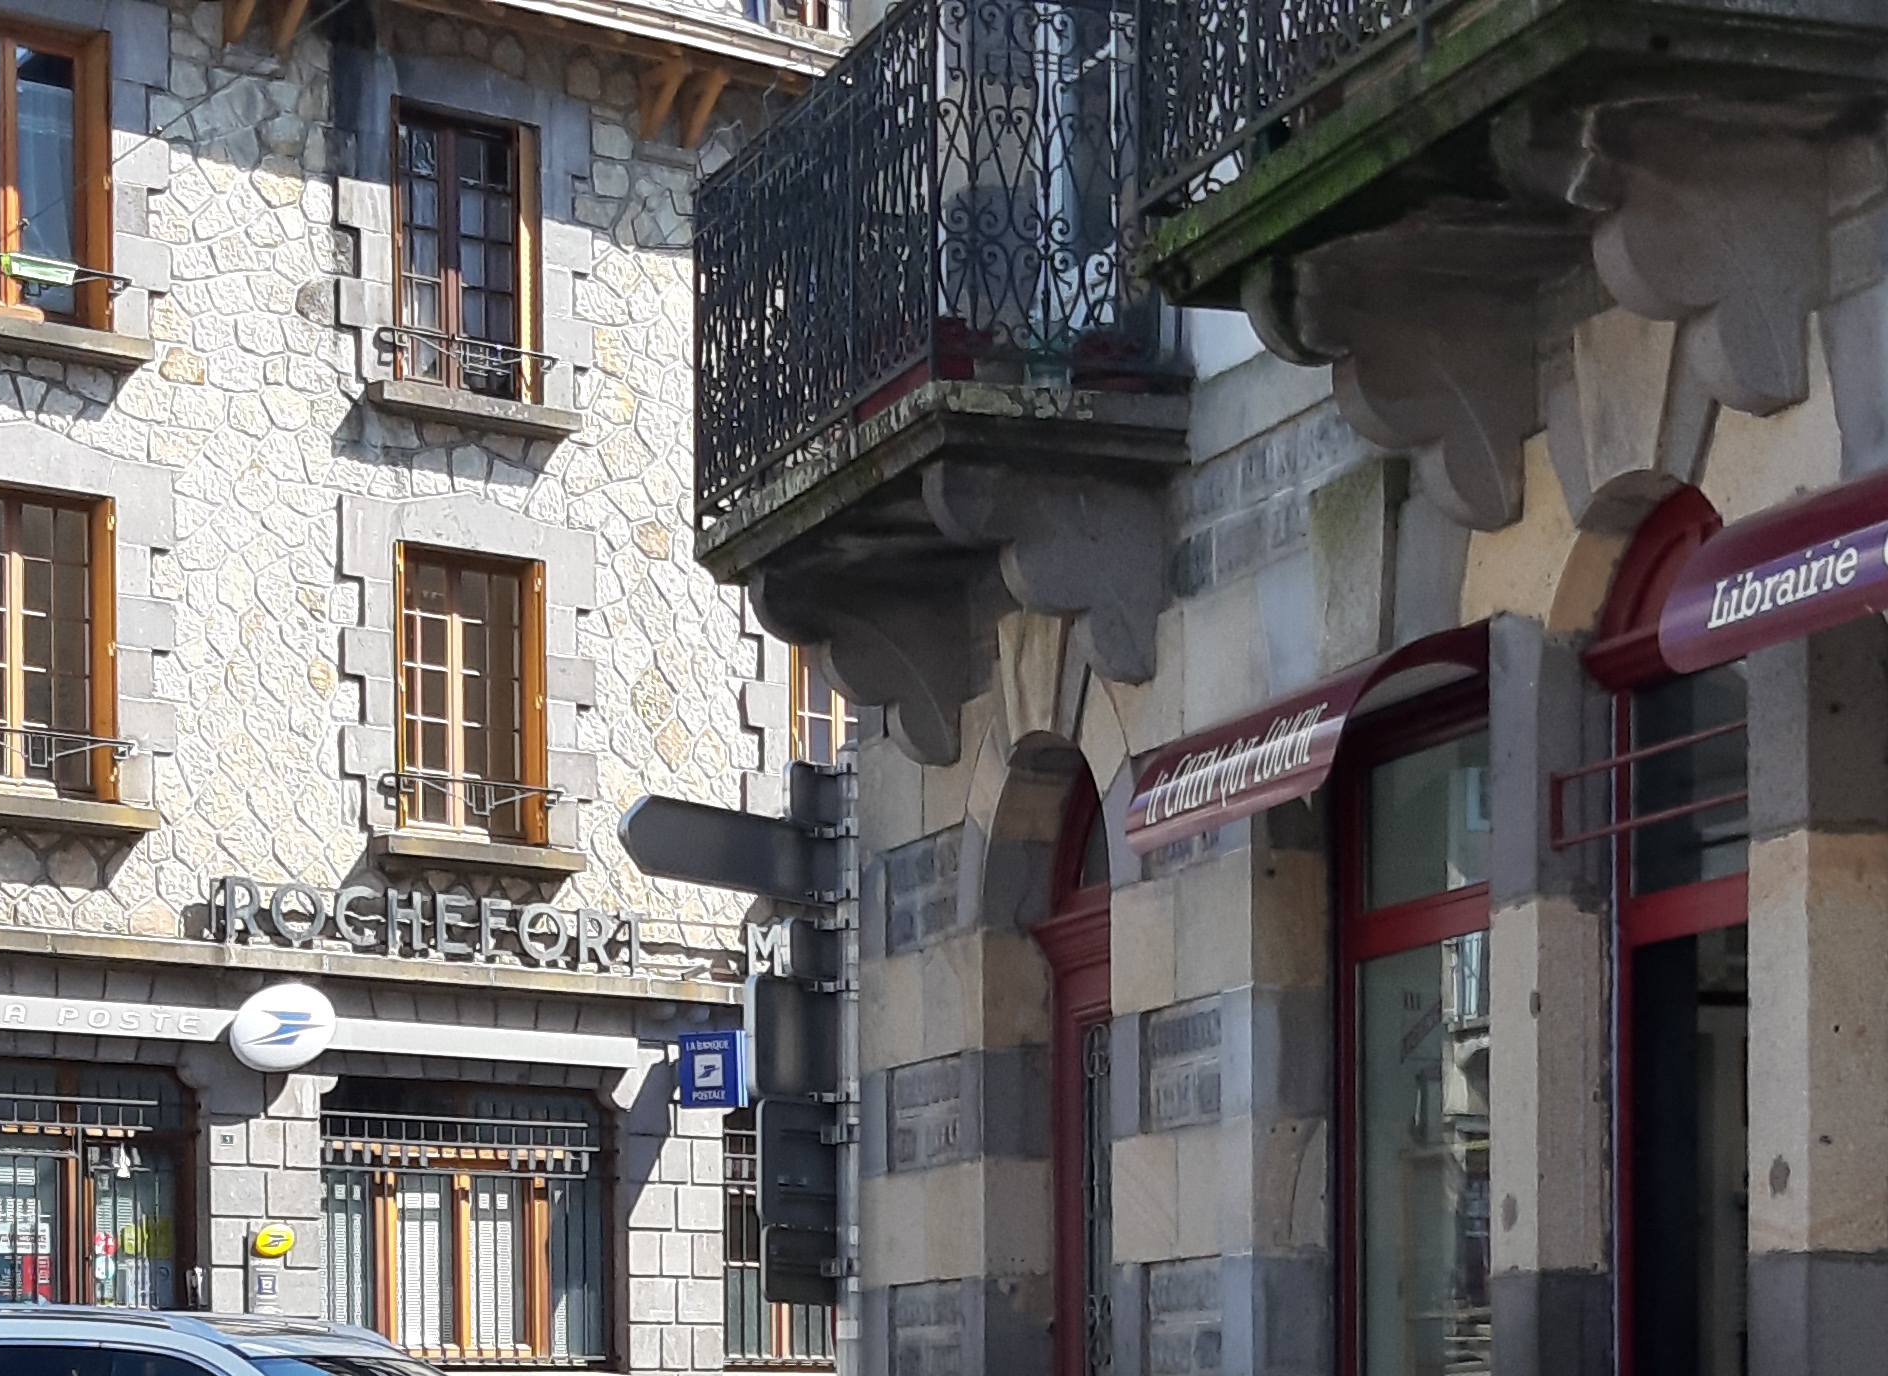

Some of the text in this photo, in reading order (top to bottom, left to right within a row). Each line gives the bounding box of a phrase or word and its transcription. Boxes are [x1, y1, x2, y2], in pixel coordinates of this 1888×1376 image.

[1706, 538, 1860, 630] Librairie
[1164, 744, 1228, 818] CHIEN
[1220, 736, 1260, 808] QUI
[1253, 701, 1328, 784] LOUCHE
[224, 877, 646, 977] ROCHEFORT
[57, 1006, 200, 1034] POSTE
[692, 1090, 726, 1101] POSTALE
